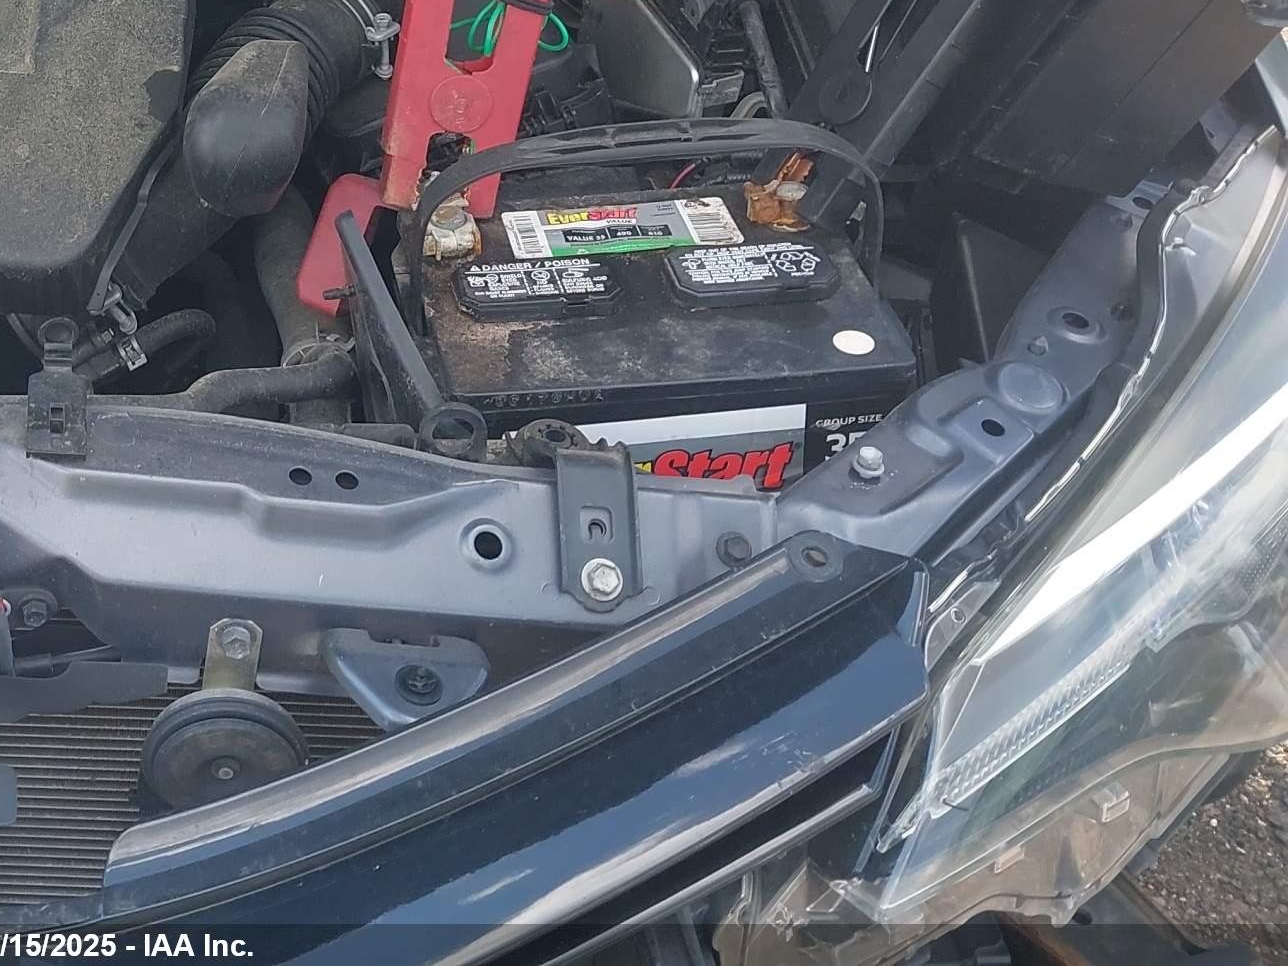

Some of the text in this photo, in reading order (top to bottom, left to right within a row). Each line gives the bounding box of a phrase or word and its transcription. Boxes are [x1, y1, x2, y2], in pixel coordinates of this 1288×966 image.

[546, 207, 637, 225] EverStart
[567, 234, 594, 242] VALUE
[481, 262, 532, 271] DANGER
[544, 258, 590, 268] POISON
[815, 414, 883, 428] GROUP SIZE
